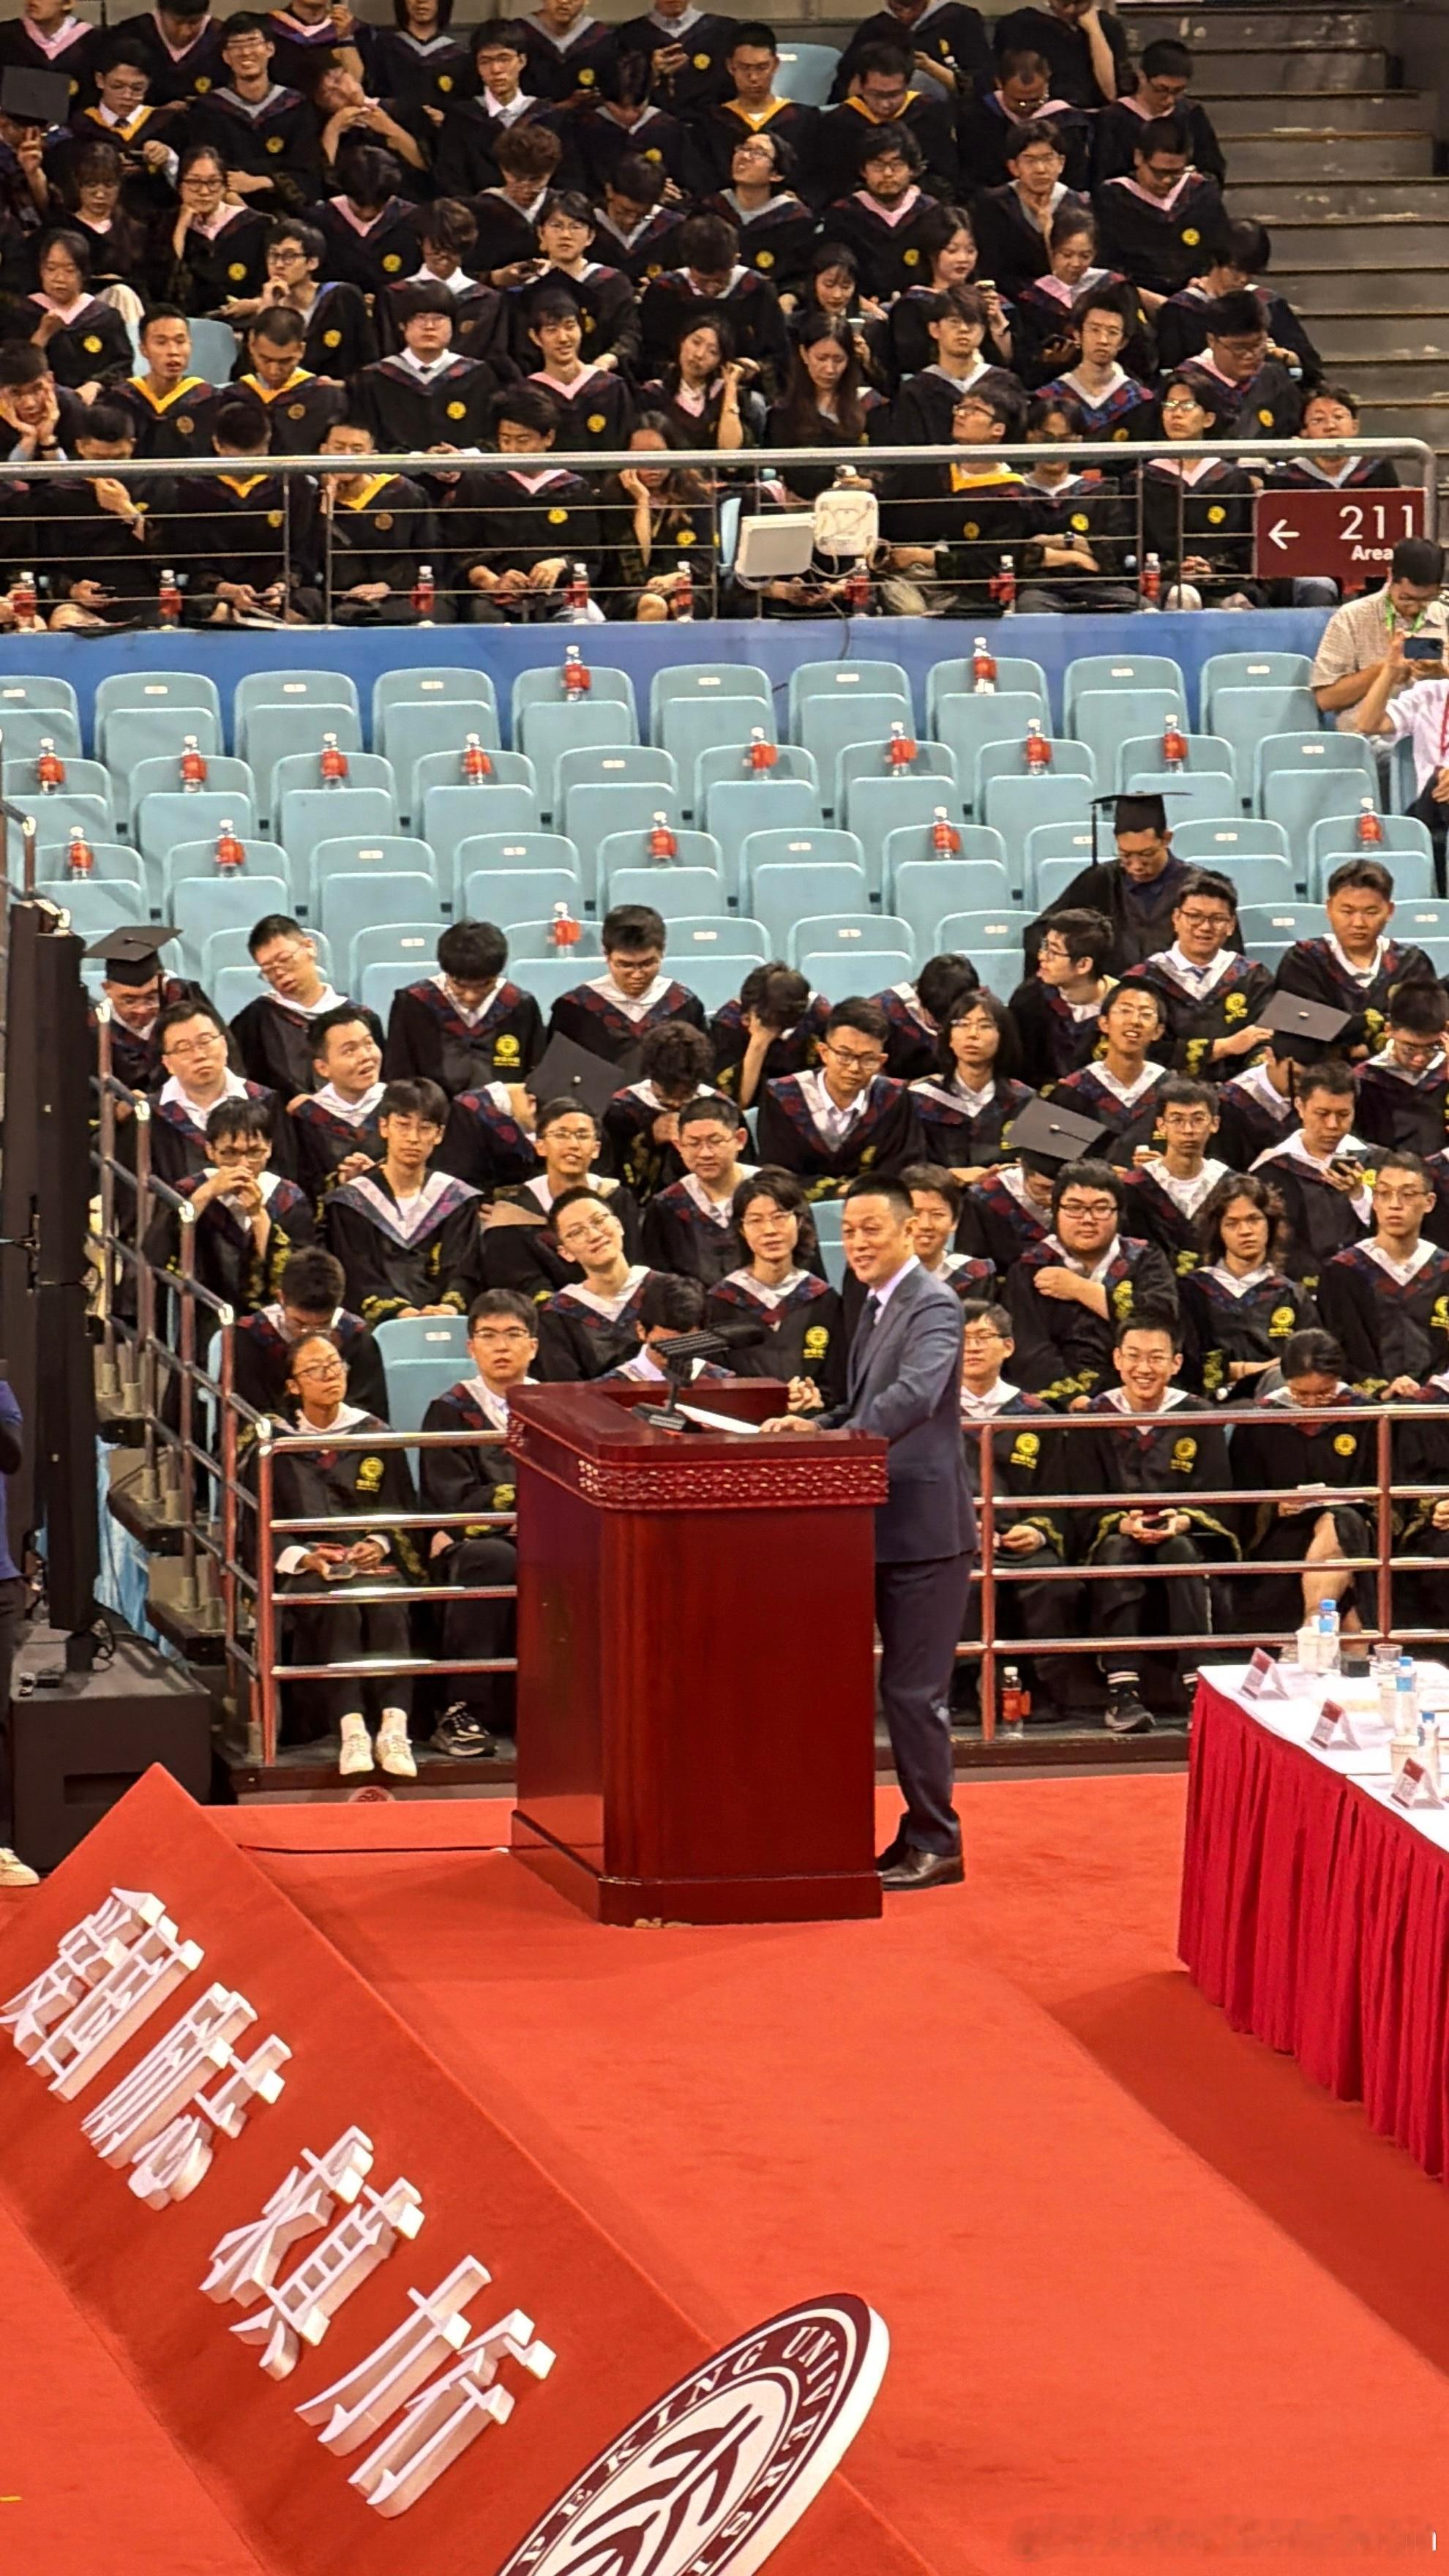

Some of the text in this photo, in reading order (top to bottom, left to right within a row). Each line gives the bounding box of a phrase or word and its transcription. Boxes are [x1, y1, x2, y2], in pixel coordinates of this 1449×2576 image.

[1339, 505, 1413, 540] 211
[1351, 544, 1394, 561] Area
[198, 2124, 425, 2379] 求真
[294, 2254, 556, 2517] 力行
[512, 2340, 767, 2564] PEKING
